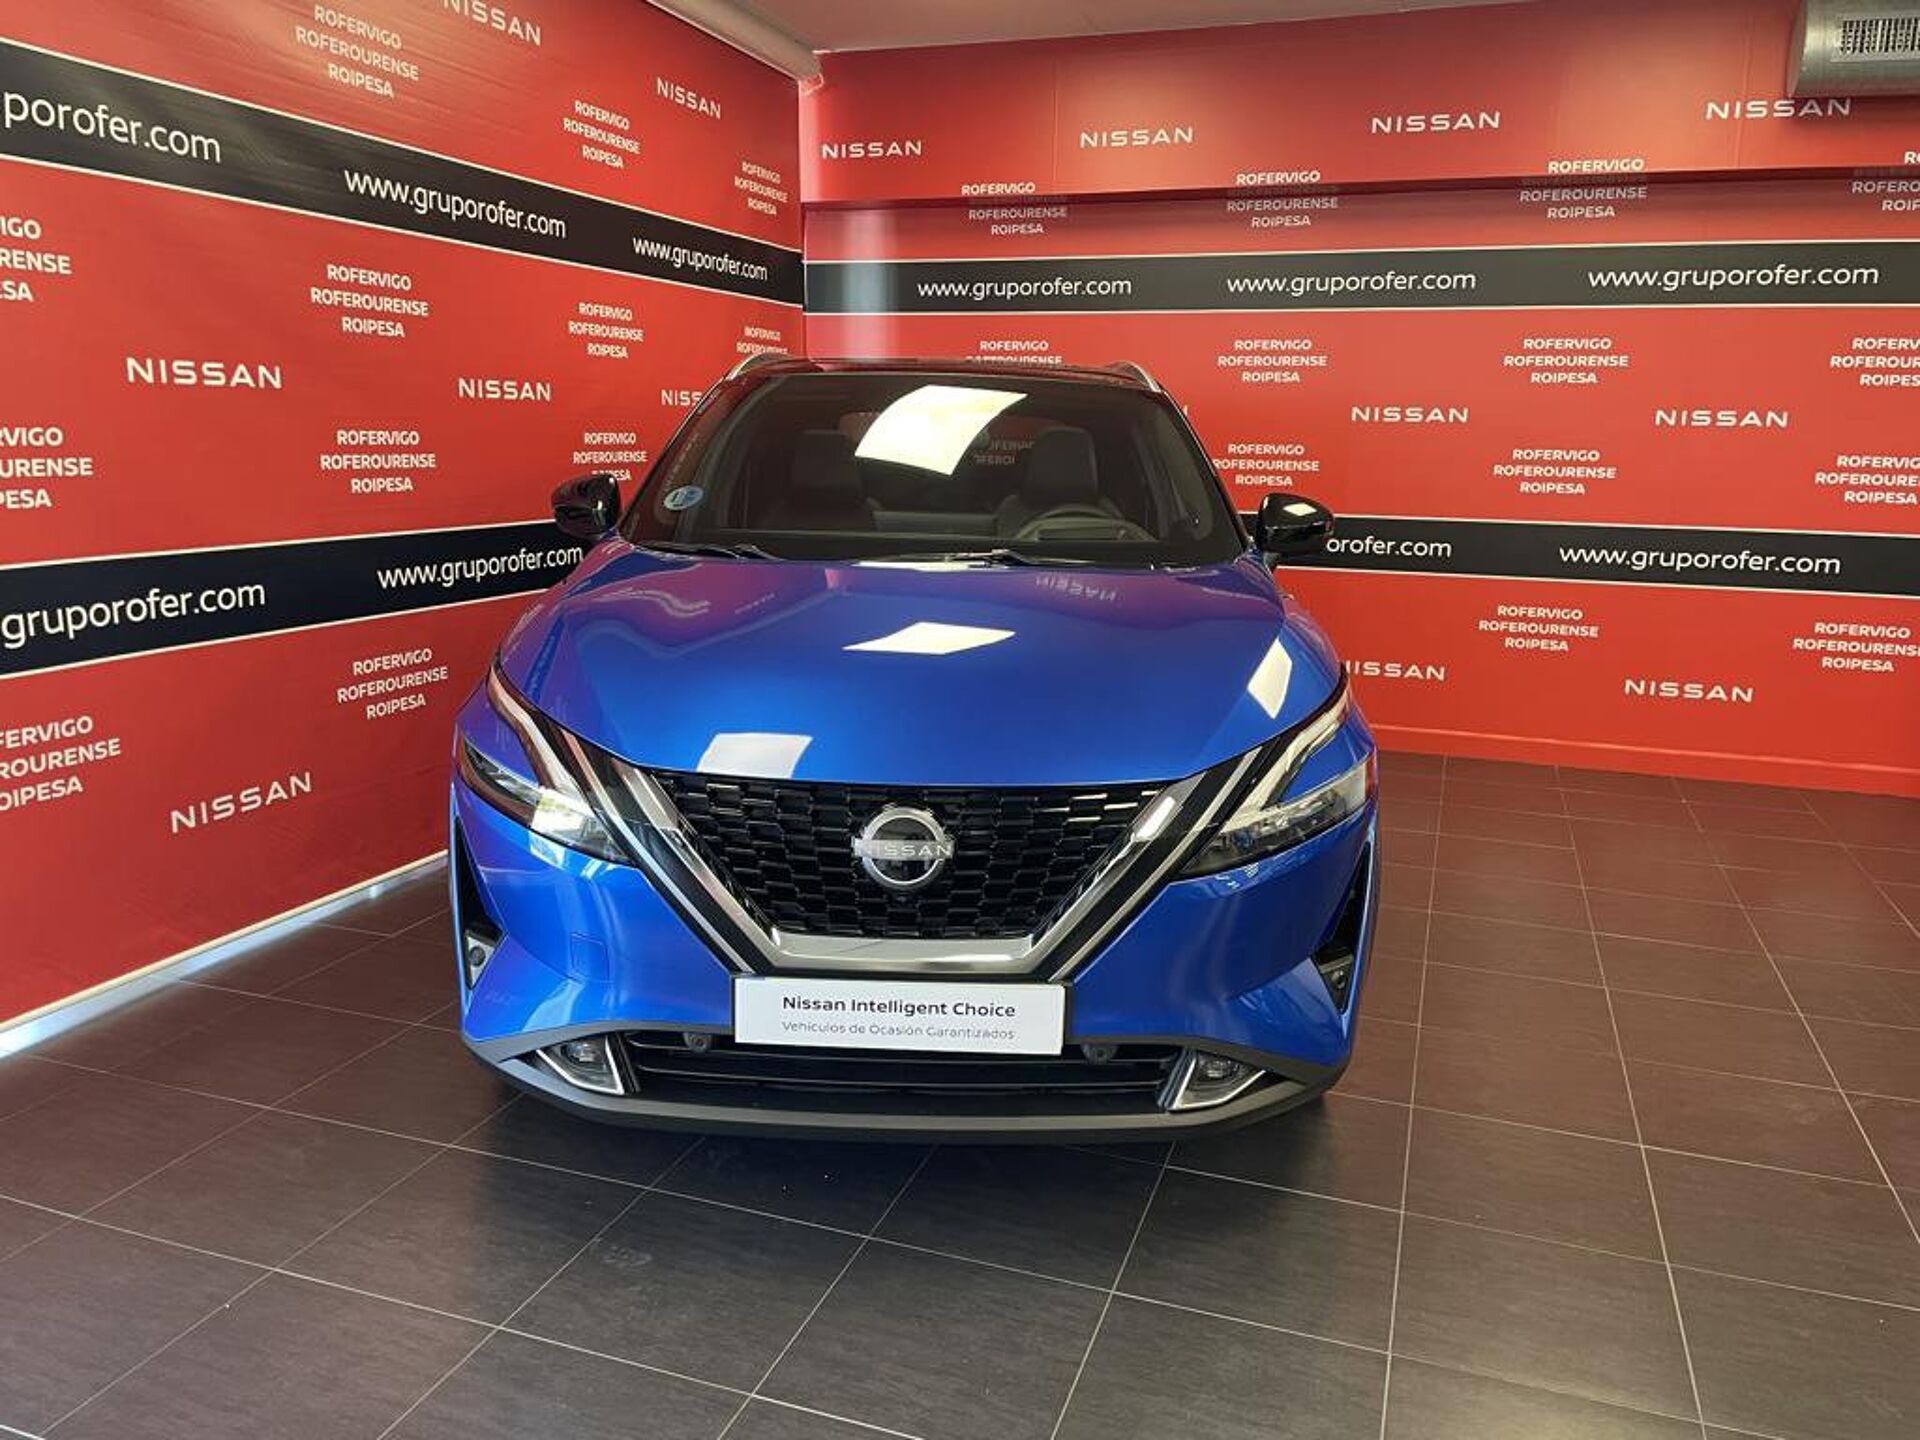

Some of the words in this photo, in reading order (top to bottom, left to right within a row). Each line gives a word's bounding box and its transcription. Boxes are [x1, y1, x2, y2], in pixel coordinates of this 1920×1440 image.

[314, 4, 402, 50] ROFERVIGO
[443, 0, 541, 46] NISSAN
[295, 25, 419, 81] ROFEROURENSE
[327, 64, 395, 98] ROIPESA
[656, 77, 722, 120] NISSAN
[575, 100, 630, 131] ROFERVIGO
[1705, 99, 1851, 120] NISSAN
[4, 91, 221, 163] porofer.com
[1371, 111, 1501, 134] NISSAN
[563, 118, 640, 155] ROFEROURENSE
[1081, 127, 1193, 149] NISSAN
[582, 145, 624, 169] ROIPESA
[822, 140, 923, 159] NISSAN
[1548, 159, 1645, 173] ROFERVIGO
[1237, 170, 1321, 185] ROFERVIGO
[961, 182, 1036, 196] ROFERVIGO
[1519, 186, 1648, 202] ROFEROURENSE
[344, 170, 566, 239] www.gruporofer.com
[968, 207, 1068, 220] ROFEROURENSE
[1227, 197, 1339, 212] ROFEROURENSE
[1547, 206, 1616, 219] ROIPESA
[991, 224, 1045, 236] ROIPESA
[1251, 215, 1312, 228] ROIPESA
[633, 235, 768, 282] www.gruporofer.com
[327, 264, 412, 291] ROFERVIGO
[1227, 270, 1477, 297] www.gruporofer.com
[1588, 264, 1879, 291] www.gruporofer.com
[0, 279, 34, 302] SA
[918, 277, 1132, 301] www.gruporofer.com
[311, 287, 429, 317] ROFEROURENSE
[578, 302, 633, 322] ROFERVIGO
[341, 317, 406, 339] ROIPESA
[568, 320, 644, 342] ROFEROURENSE
[587, 342, 628, 360] ROIPESA
[980, 340, 1049, 351] ROFERVIGO
[1234, 339, 1312, 351] ROFERVIGO
[1523, 338, 1612, 350] ROFERVIGO
[1218, 355, 1328, 367] ROFEROURENSE
[1503, 354, 1629, 368] ROFEROURENSE
[126, 357, 282, 389] NISSAN
[1242, 371, 1301, 383] ROIPESA
[1530, 372, 1597, 384] ROIPESA
[458, 378, 551, 402] NISSAN
[1351, 406, 1469, 423] NISSAN
[1655, 409, 1788, 428] NISSAN
[337, 430, 420, 446] ROFERVIGO
[583, 432, 636, 446] ROFERVIGO
[573, 450, 648, 464] ROFEROURENSE
[1228, 443, 1304, 455] ROFERVIGO
[1512, 448, 1600, 462] ROFERVIGO
[320, 453, 437, 471] ROFEROURENSE
[1212, 459, 1320, 472] ROFEROURENSE
[1235, 474, 1293, 487] ROIPESA
[1493, 464, 1617, 479] ROFEROURENSE
[1814, 472, 1920, 487] ROFEROURE
[351, 477, 413, 494] ROIPESA
[1519, 481, 1586, 495] ROIPESA
[1844, 490, 1918, 505] ROIPESA
[1326, 535, 1452, 558] orofer.com
[377, 545, 583, 590] www.gruporofer.com
[1559, 544, 1841, 574] www.gruporofer.com
[1, 583, 266, 649] gruporofer.com
[1497, 605, 1584, 620] ROFERVIGO
[1479, 620, 1599, 638] ROFEROURENSE
[1815, 622, 1911, 639] ROFERVIGO
[1504, 637, 1569, 651] ROIPESA
[1793, 638, 1920, 657] ROFEROURENS
[352, 648, 433, 676] ROFERVIGO
[1822, 657, 1894, 672] ROIPESA
[337, 666, 449, 703] ROFEROURENSE
[1624, 678, 1754, 703] NISSAN
[365, 693, 427, 720] ROIPESA
[170, 772, 312, 833] NISSAN
[866, 844, 952, 857] SSAN
[783, 996, 846, 1012] Nissan
[851, 999, 948, 1017] Intelligent
[952, 1001, 1016, 1017] Choice
[848, 1022, 866, 1034] de
[927, 1026, 1015, 1040] Garantizados
